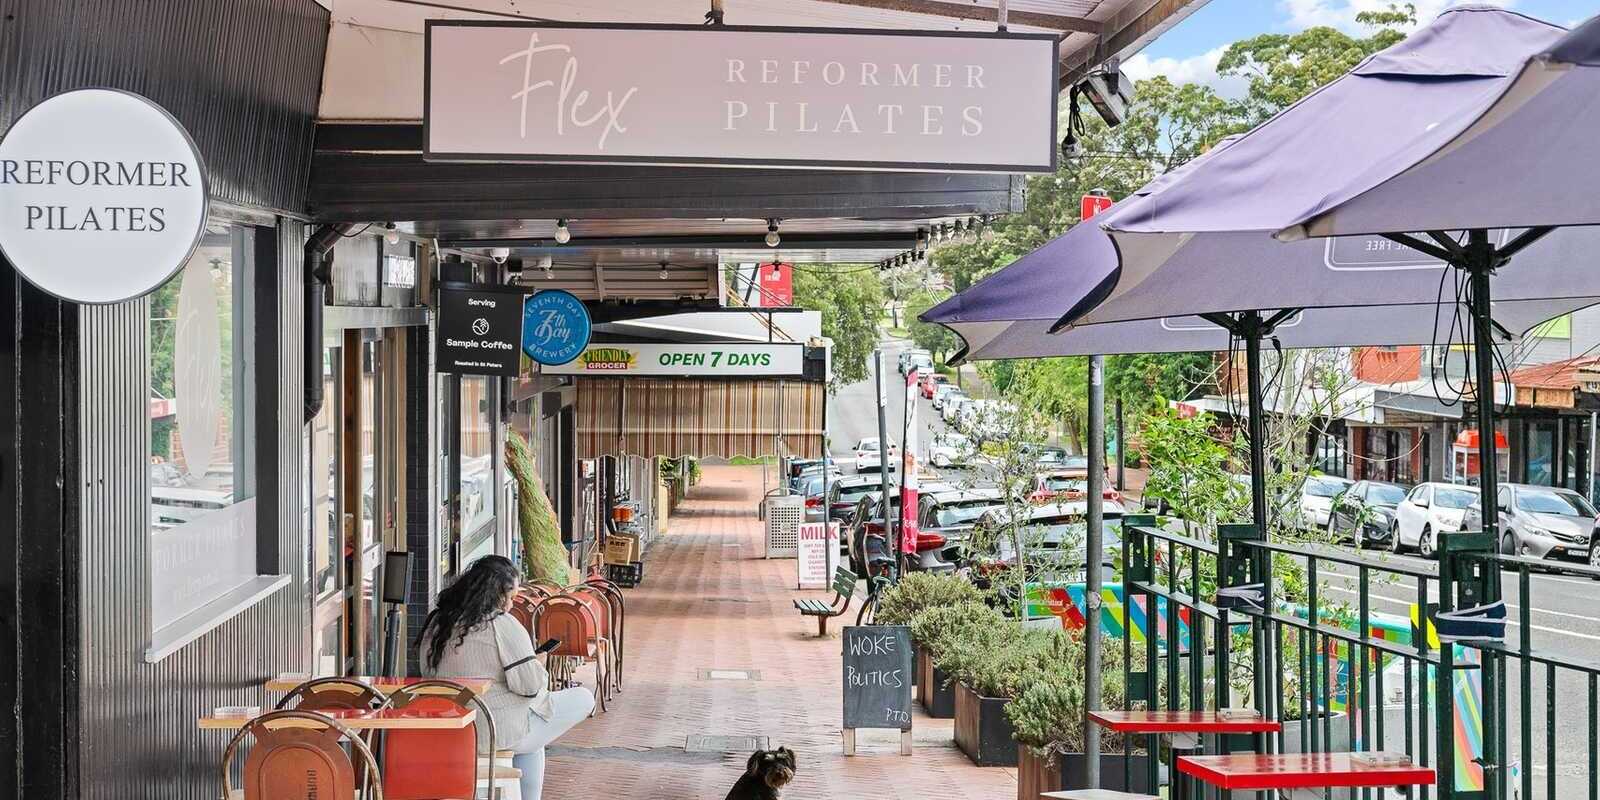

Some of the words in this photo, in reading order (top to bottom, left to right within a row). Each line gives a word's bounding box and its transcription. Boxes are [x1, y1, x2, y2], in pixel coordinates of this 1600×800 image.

[726, 59, 987, 89] REFORMER
[500, 32, 638, 150] Flex
[724, 101, 984, 137] PILATES
[0, 160, 191, 188] REFORMER
[24, 205, 166, 233] PILATES
[468, 298, 496, 309] Serving
[525, 296, 565, 318] SEVENTH
[566, 303, 582, 319] DAY
[446, 338, 479, 349] Sample
[480, 340, 513, 350] Coffee
[528, 343, 578, 359] BREWERY
[585, 349, 630, 362] FRIENDLY
[659, 352, 704, 367] OPEN
[710, 351, 724, 367] 7
[727, 352, 771, 367] DAYS
[588, 362, 627, 370] GROCER
[800, 526, 838, 540] MILK
[849, 634, 896, 656] WOKE
